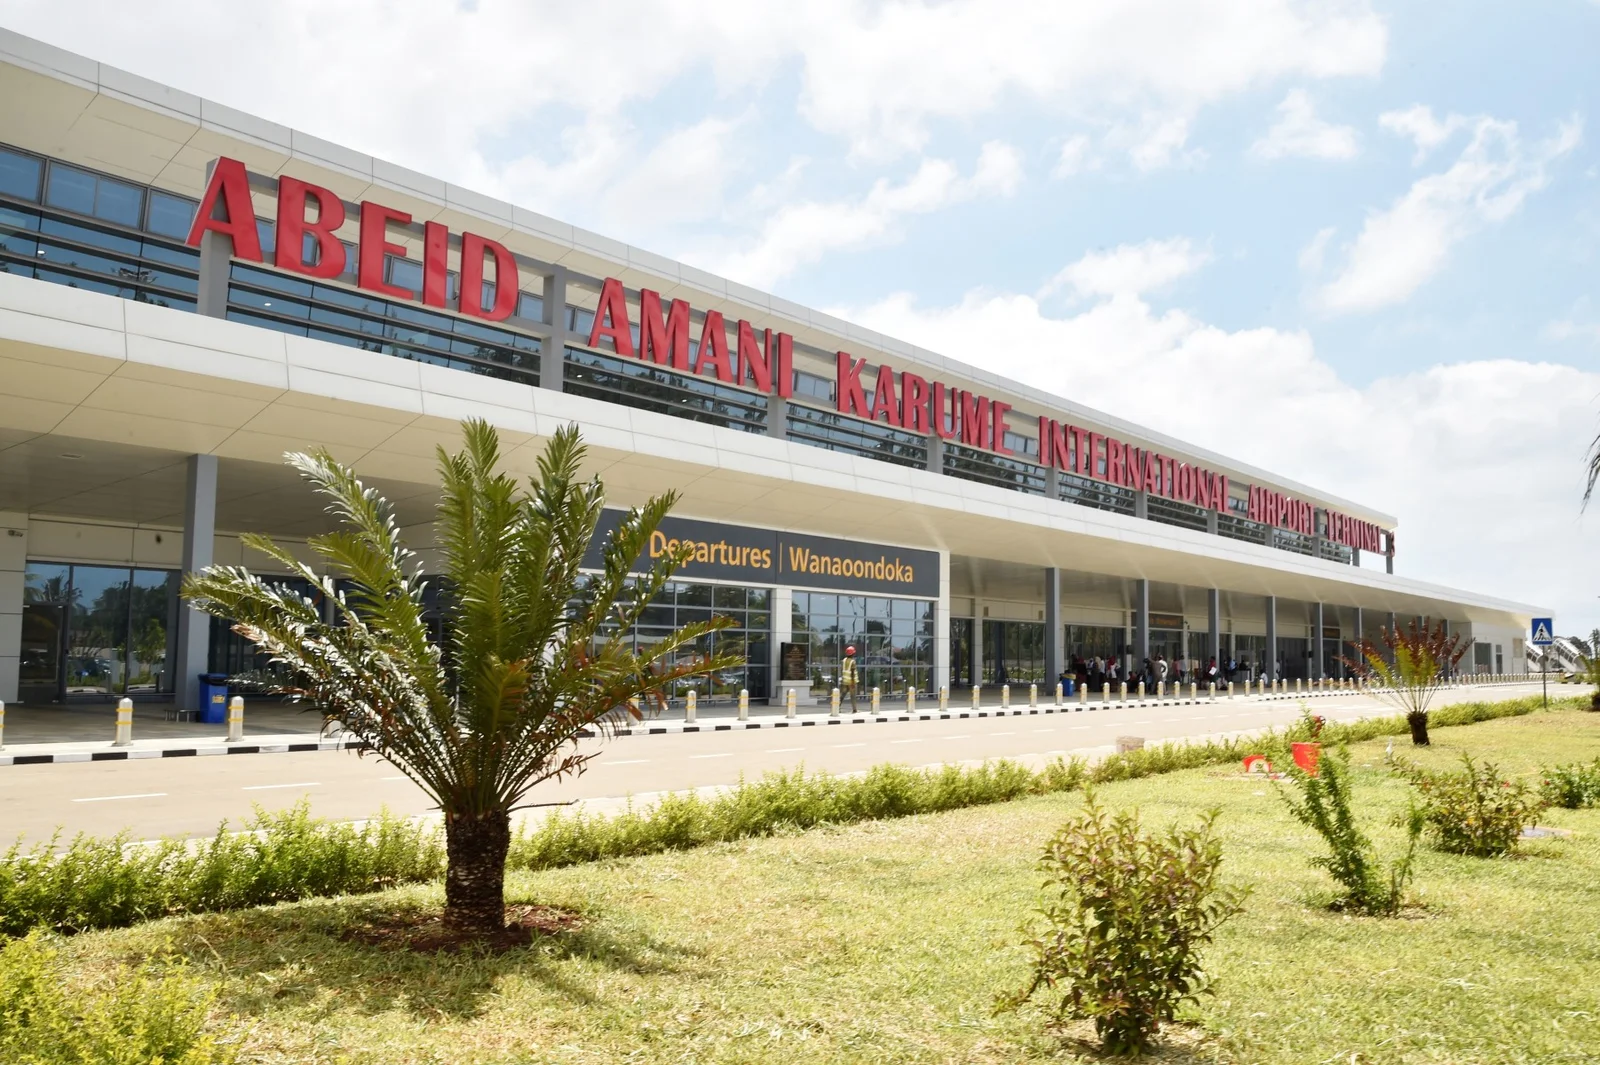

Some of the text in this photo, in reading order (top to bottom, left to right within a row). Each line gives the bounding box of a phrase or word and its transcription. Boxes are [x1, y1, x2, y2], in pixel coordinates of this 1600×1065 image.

[186, 157, 520, 323] ABEID
[588, 278, 794, 400] AMANI
[836, 351, 1014, 457] KARUME
[1039, 416, 1233, 515] INTERNATIONAL
[1247, 484, 1315, 536] AIRPORT
[1325, 510, 1385, 554] TERMINAL
[649, 530, 914, 583] Departures Wanaoondoka
